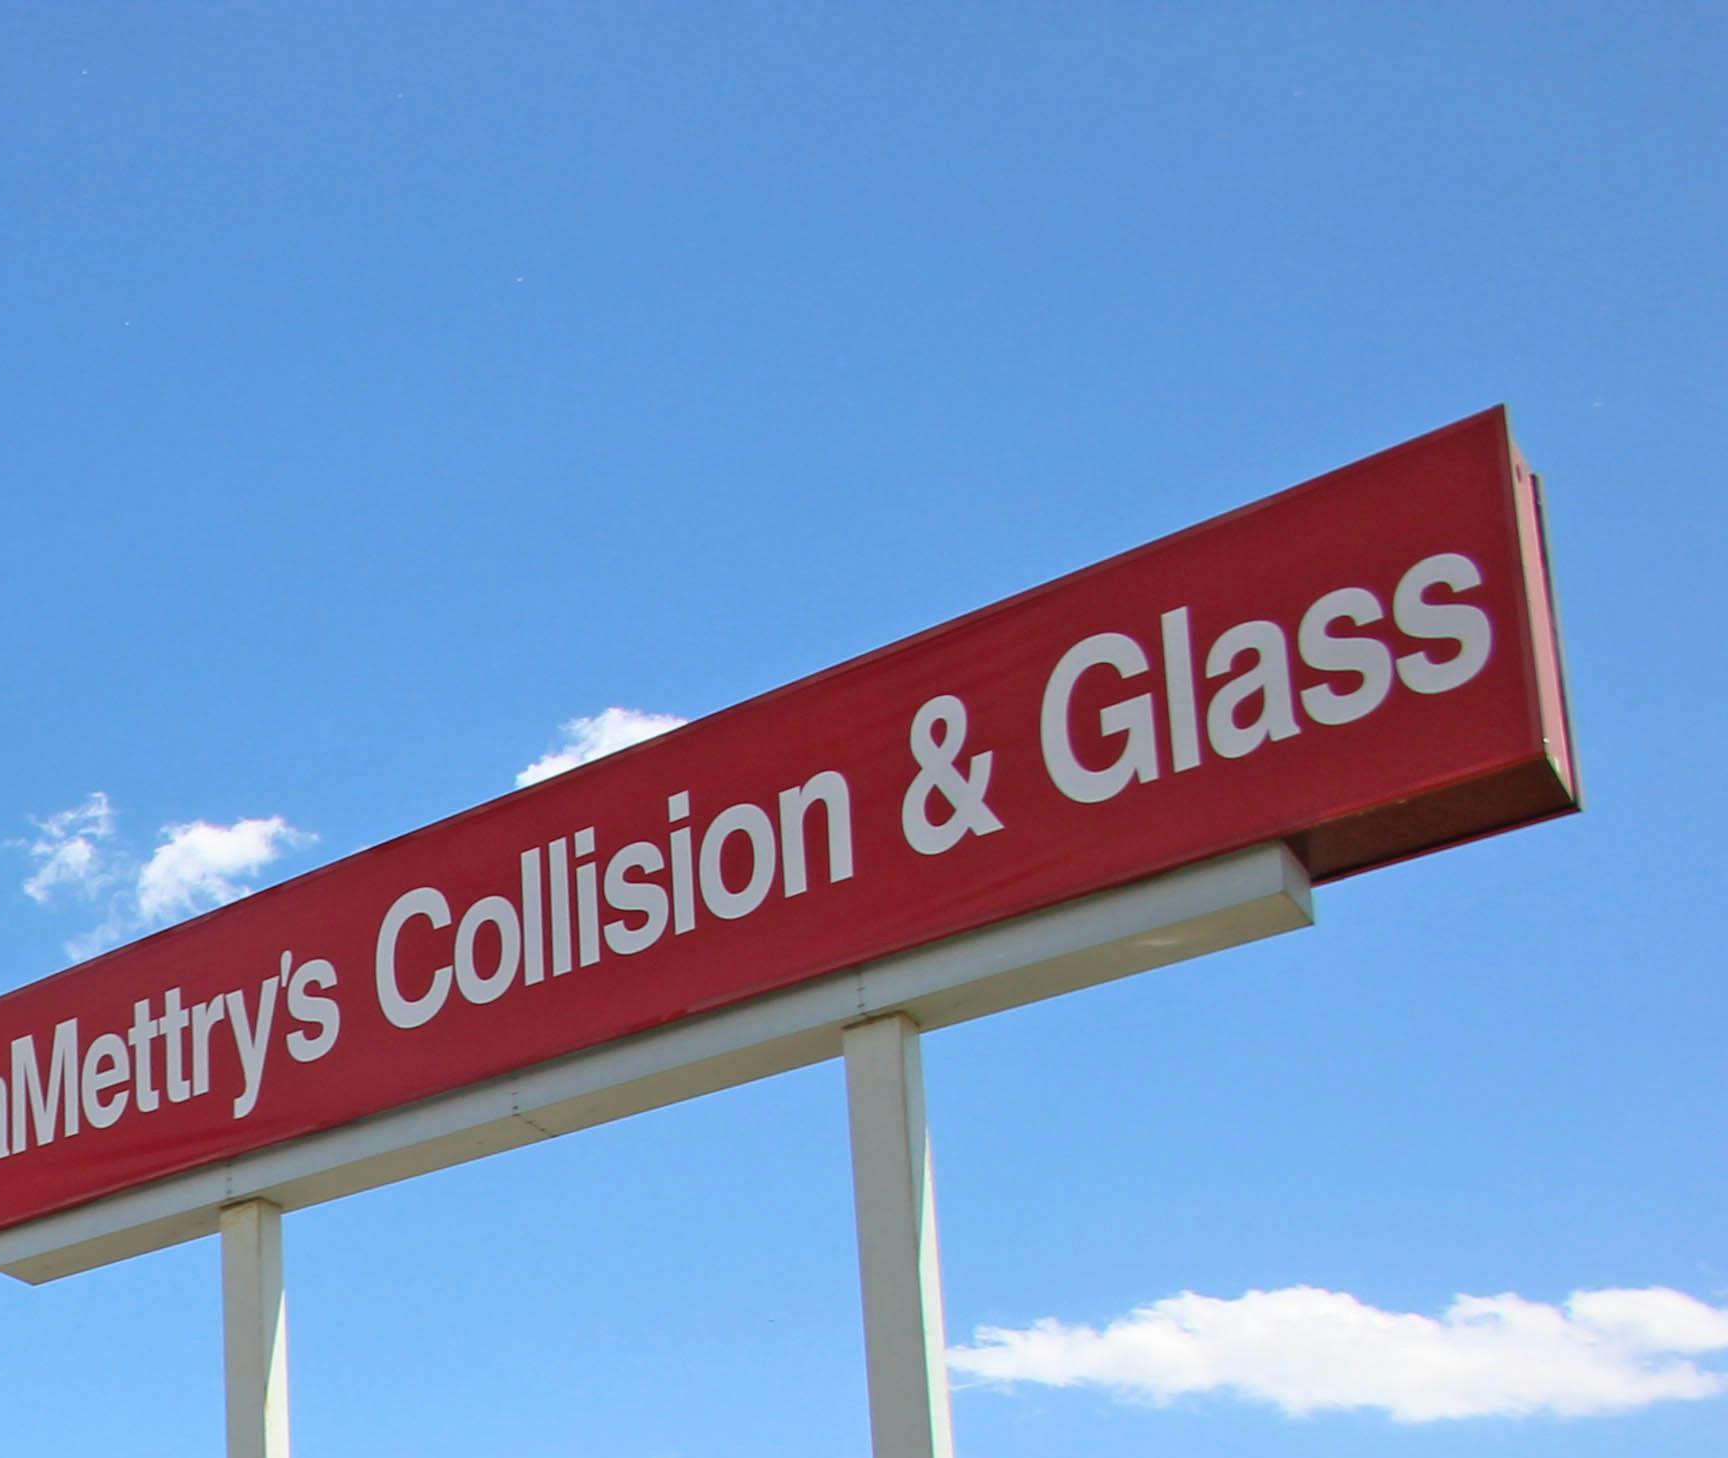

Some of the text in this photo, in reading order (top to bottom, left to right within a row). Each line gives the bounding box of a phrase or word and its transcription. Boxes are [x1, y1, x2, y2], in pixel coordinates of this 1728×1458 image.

[376, 771, 854, 1028] Collision
[903, 696, 1003, 854] &
[1042, 554, 1491, 802] Glass
